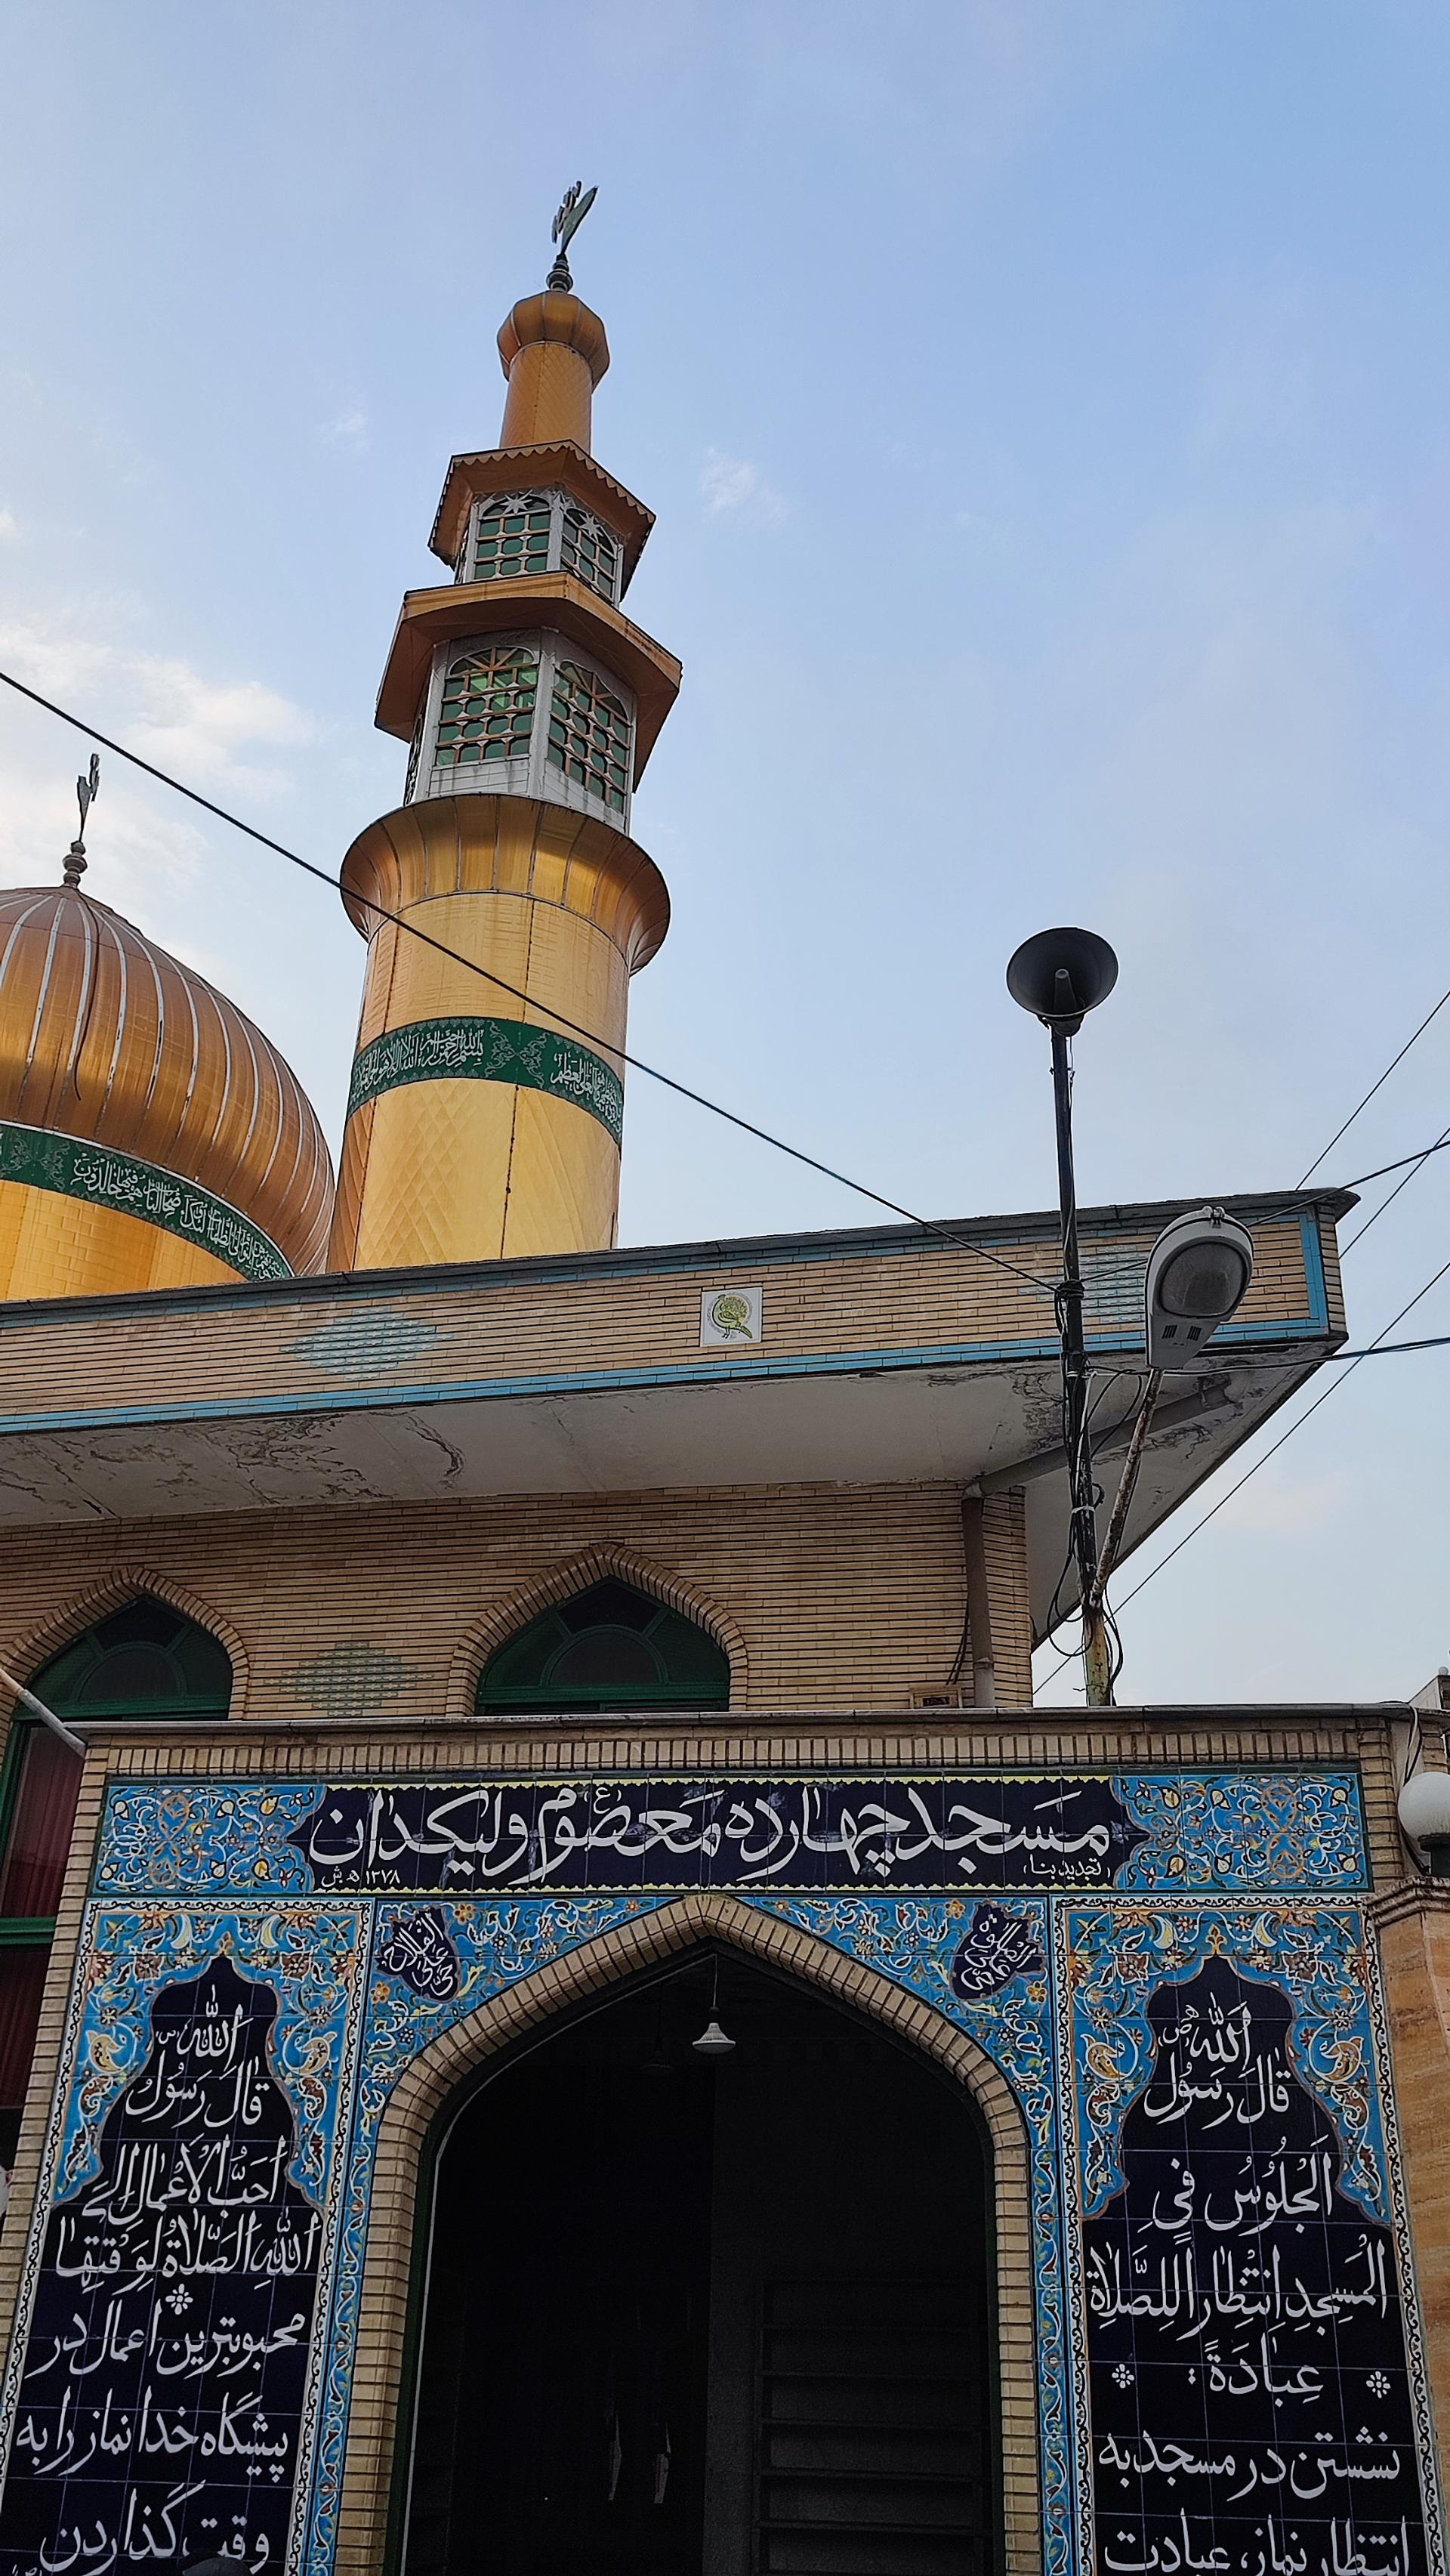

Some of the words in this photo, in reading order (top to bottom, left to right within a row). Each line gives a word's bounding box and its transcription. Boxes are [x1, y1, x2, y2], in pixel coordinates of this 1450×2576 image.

[308, 1789, 529, 1875] ولیکدان
[508, 1787, 723, 1885] معصوم
[725, 1786, 911, 1882] چهارده
[896, 1787, 1110, 1873] مسجد
[176, 1991, 248, 2072] الله
[1189, 1994, 1252, 2071] الله
[125, 2049, 208, 2129] رسول
[204, 2056, 270, 2128] قال
[1143, 2052, 1234, 2130] رسول
[1236, 2046, 1292, 2124] قال
[250, 2209, 320, 2277] الله
[1285, 2236, 1388, 2337] المسجد
[23, 2312, 88, 2380] در
[69, 2298, 163, 2376] اعمال
[156, 2312, 306, 2380] محبوبترین
[16, 2414, 48, 2466] به
[33, 2385, 75, 2476] را
[57, 2387, 133, 2477] نماز
[138, 2385, 199, 2454] خدا
[200, 2392, 289, 2482] پیشگاه
[1133, 2429, 1236, 2487] مسجد
[1098, 2432, 1131, 2488] به
[1226, 2448, 1287, 2503] در
[1290, 2426, 1401, 2500] نشستن
[39, 2479, 205, 2576] گذاردن
